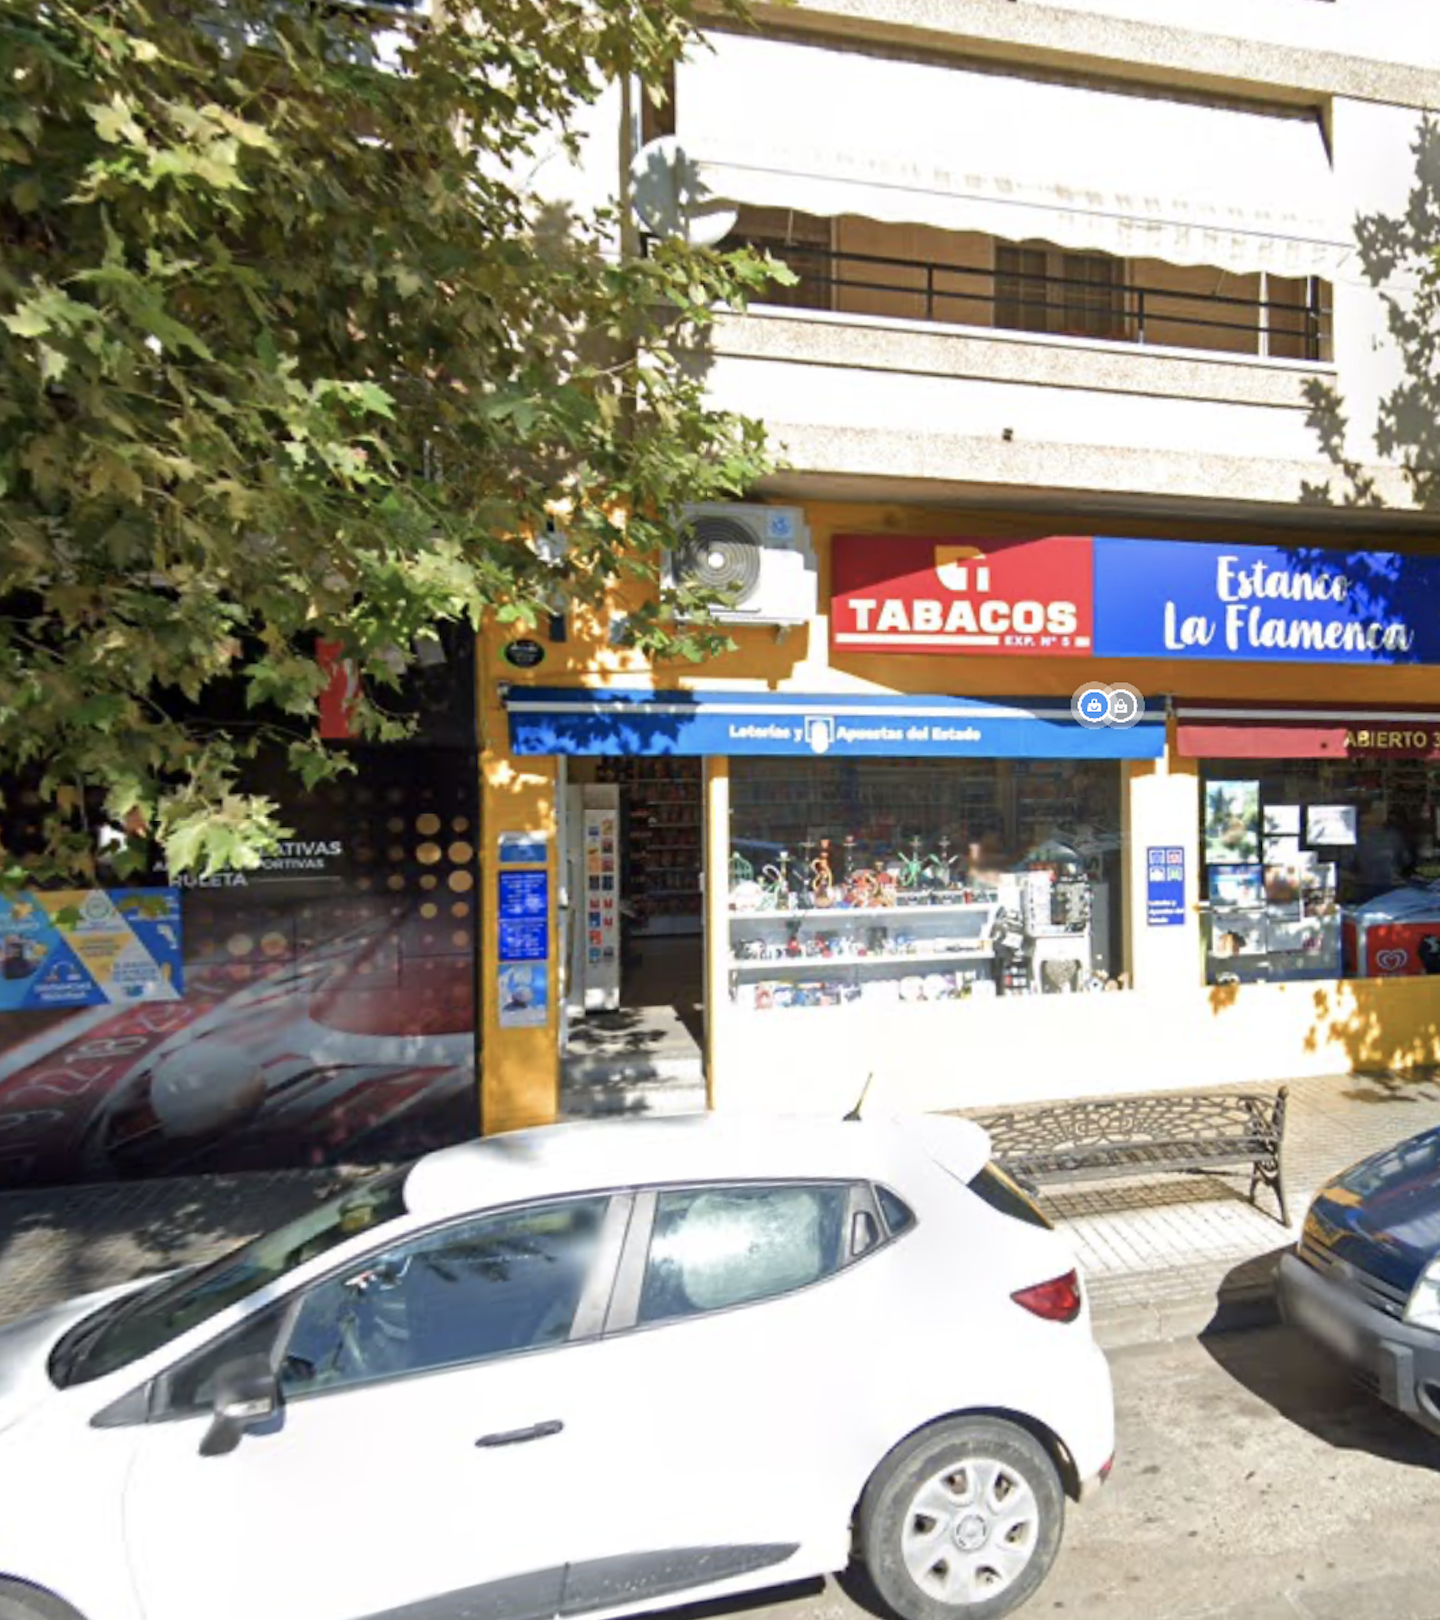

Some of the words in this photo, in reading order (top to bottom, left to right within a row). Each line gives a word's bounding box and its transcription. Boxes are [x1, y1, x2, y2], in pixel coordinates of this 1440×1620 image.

[1217, 555, 1351, 601] Estanco
[848, 599, 1077, 634] TABACOS
[1164, 601, 1215, 650] La
[1225, 604, 1414, 651] Flamenca
[1344, 731, 1426, 748] ABIERTO
